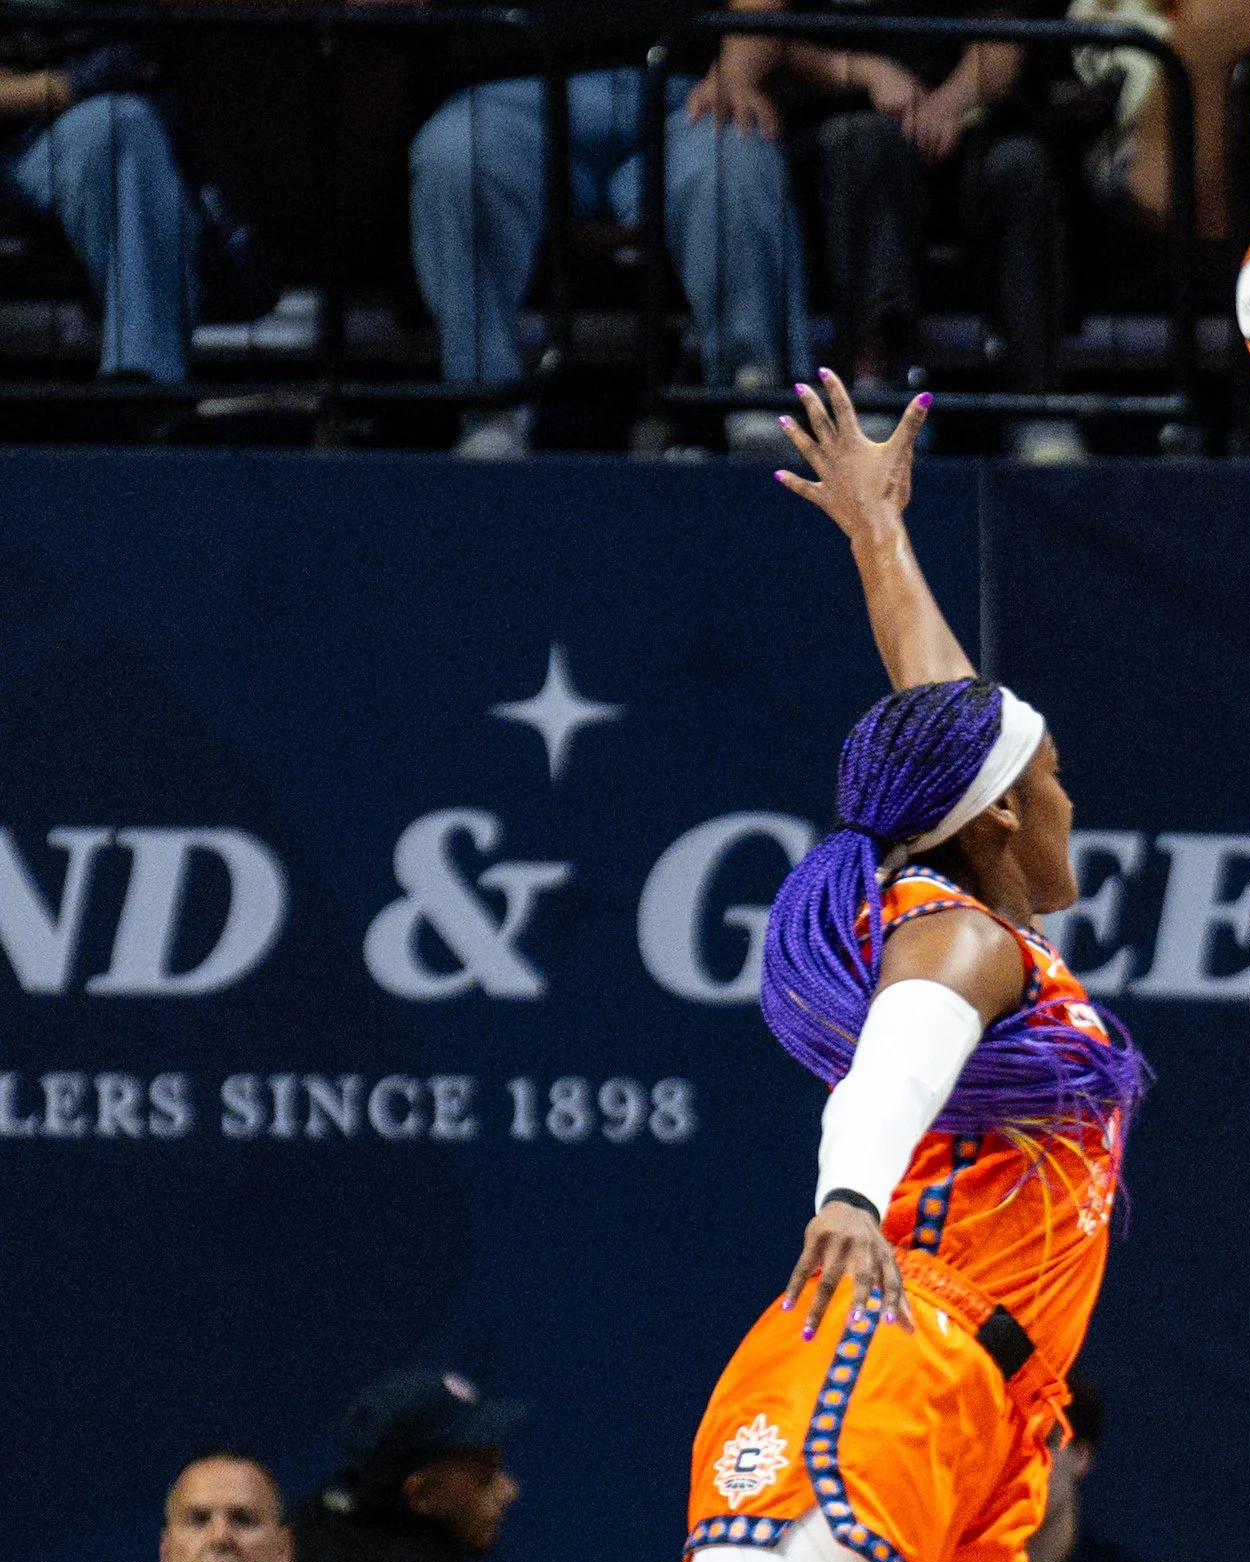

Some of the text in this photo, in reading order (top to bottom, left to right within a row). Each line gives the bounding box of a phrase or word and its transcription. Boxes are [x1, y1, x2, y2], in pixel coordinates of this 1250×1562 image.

[0, 826, 287, 997] ND
[363, 807, 573, 1000] &
[0, 1071, 697, 1143] LERS SINCE 1898
[734, 1448, 761, 1472] C
